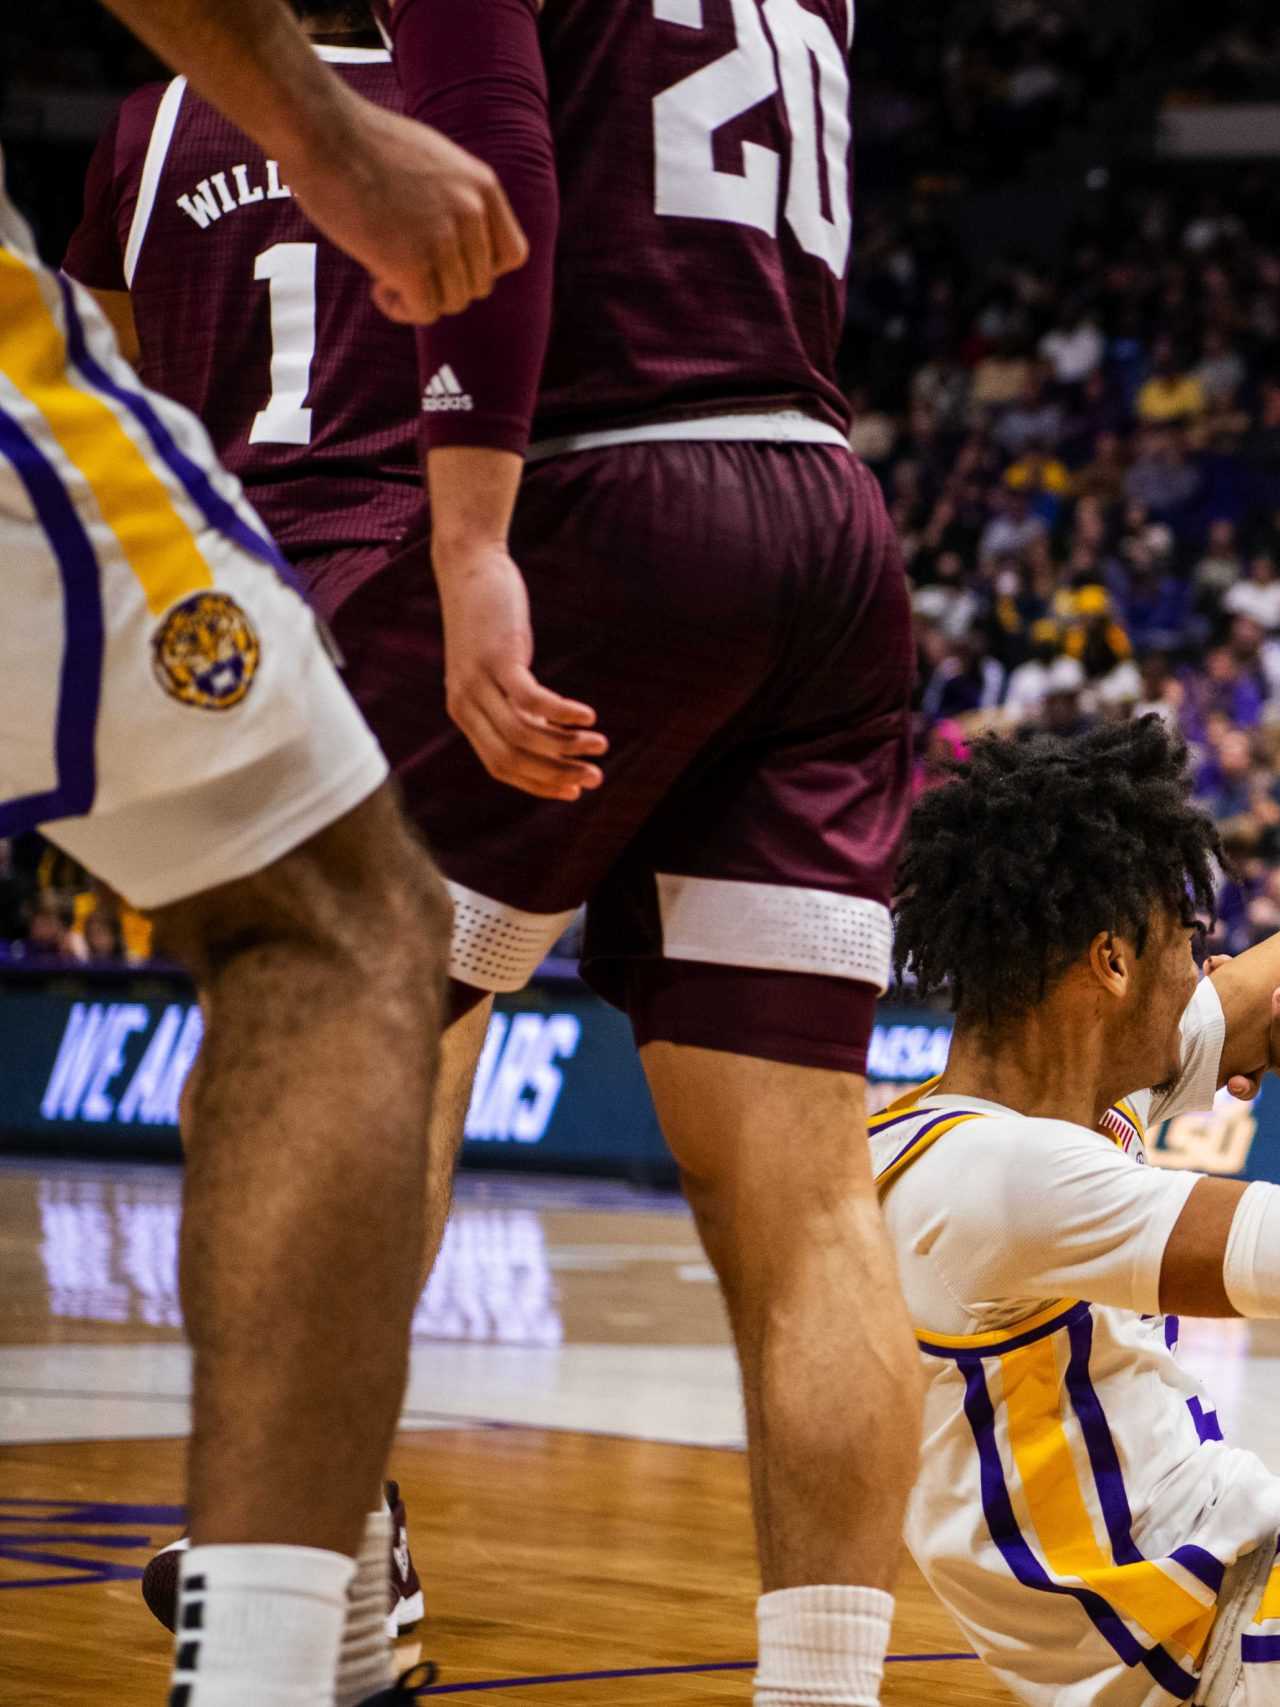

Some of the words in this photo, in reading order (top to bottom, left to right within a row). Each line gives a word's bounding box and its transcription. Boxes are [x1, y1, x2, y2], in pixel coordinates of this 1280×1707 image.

[176, 160, 293, 229] WILL
[653, 0, 851, 281] 20
[249, 242, 317, 446] 1
[40, 1002, 149, 1121] WE
[117, 1003, 204, 1125] AR
